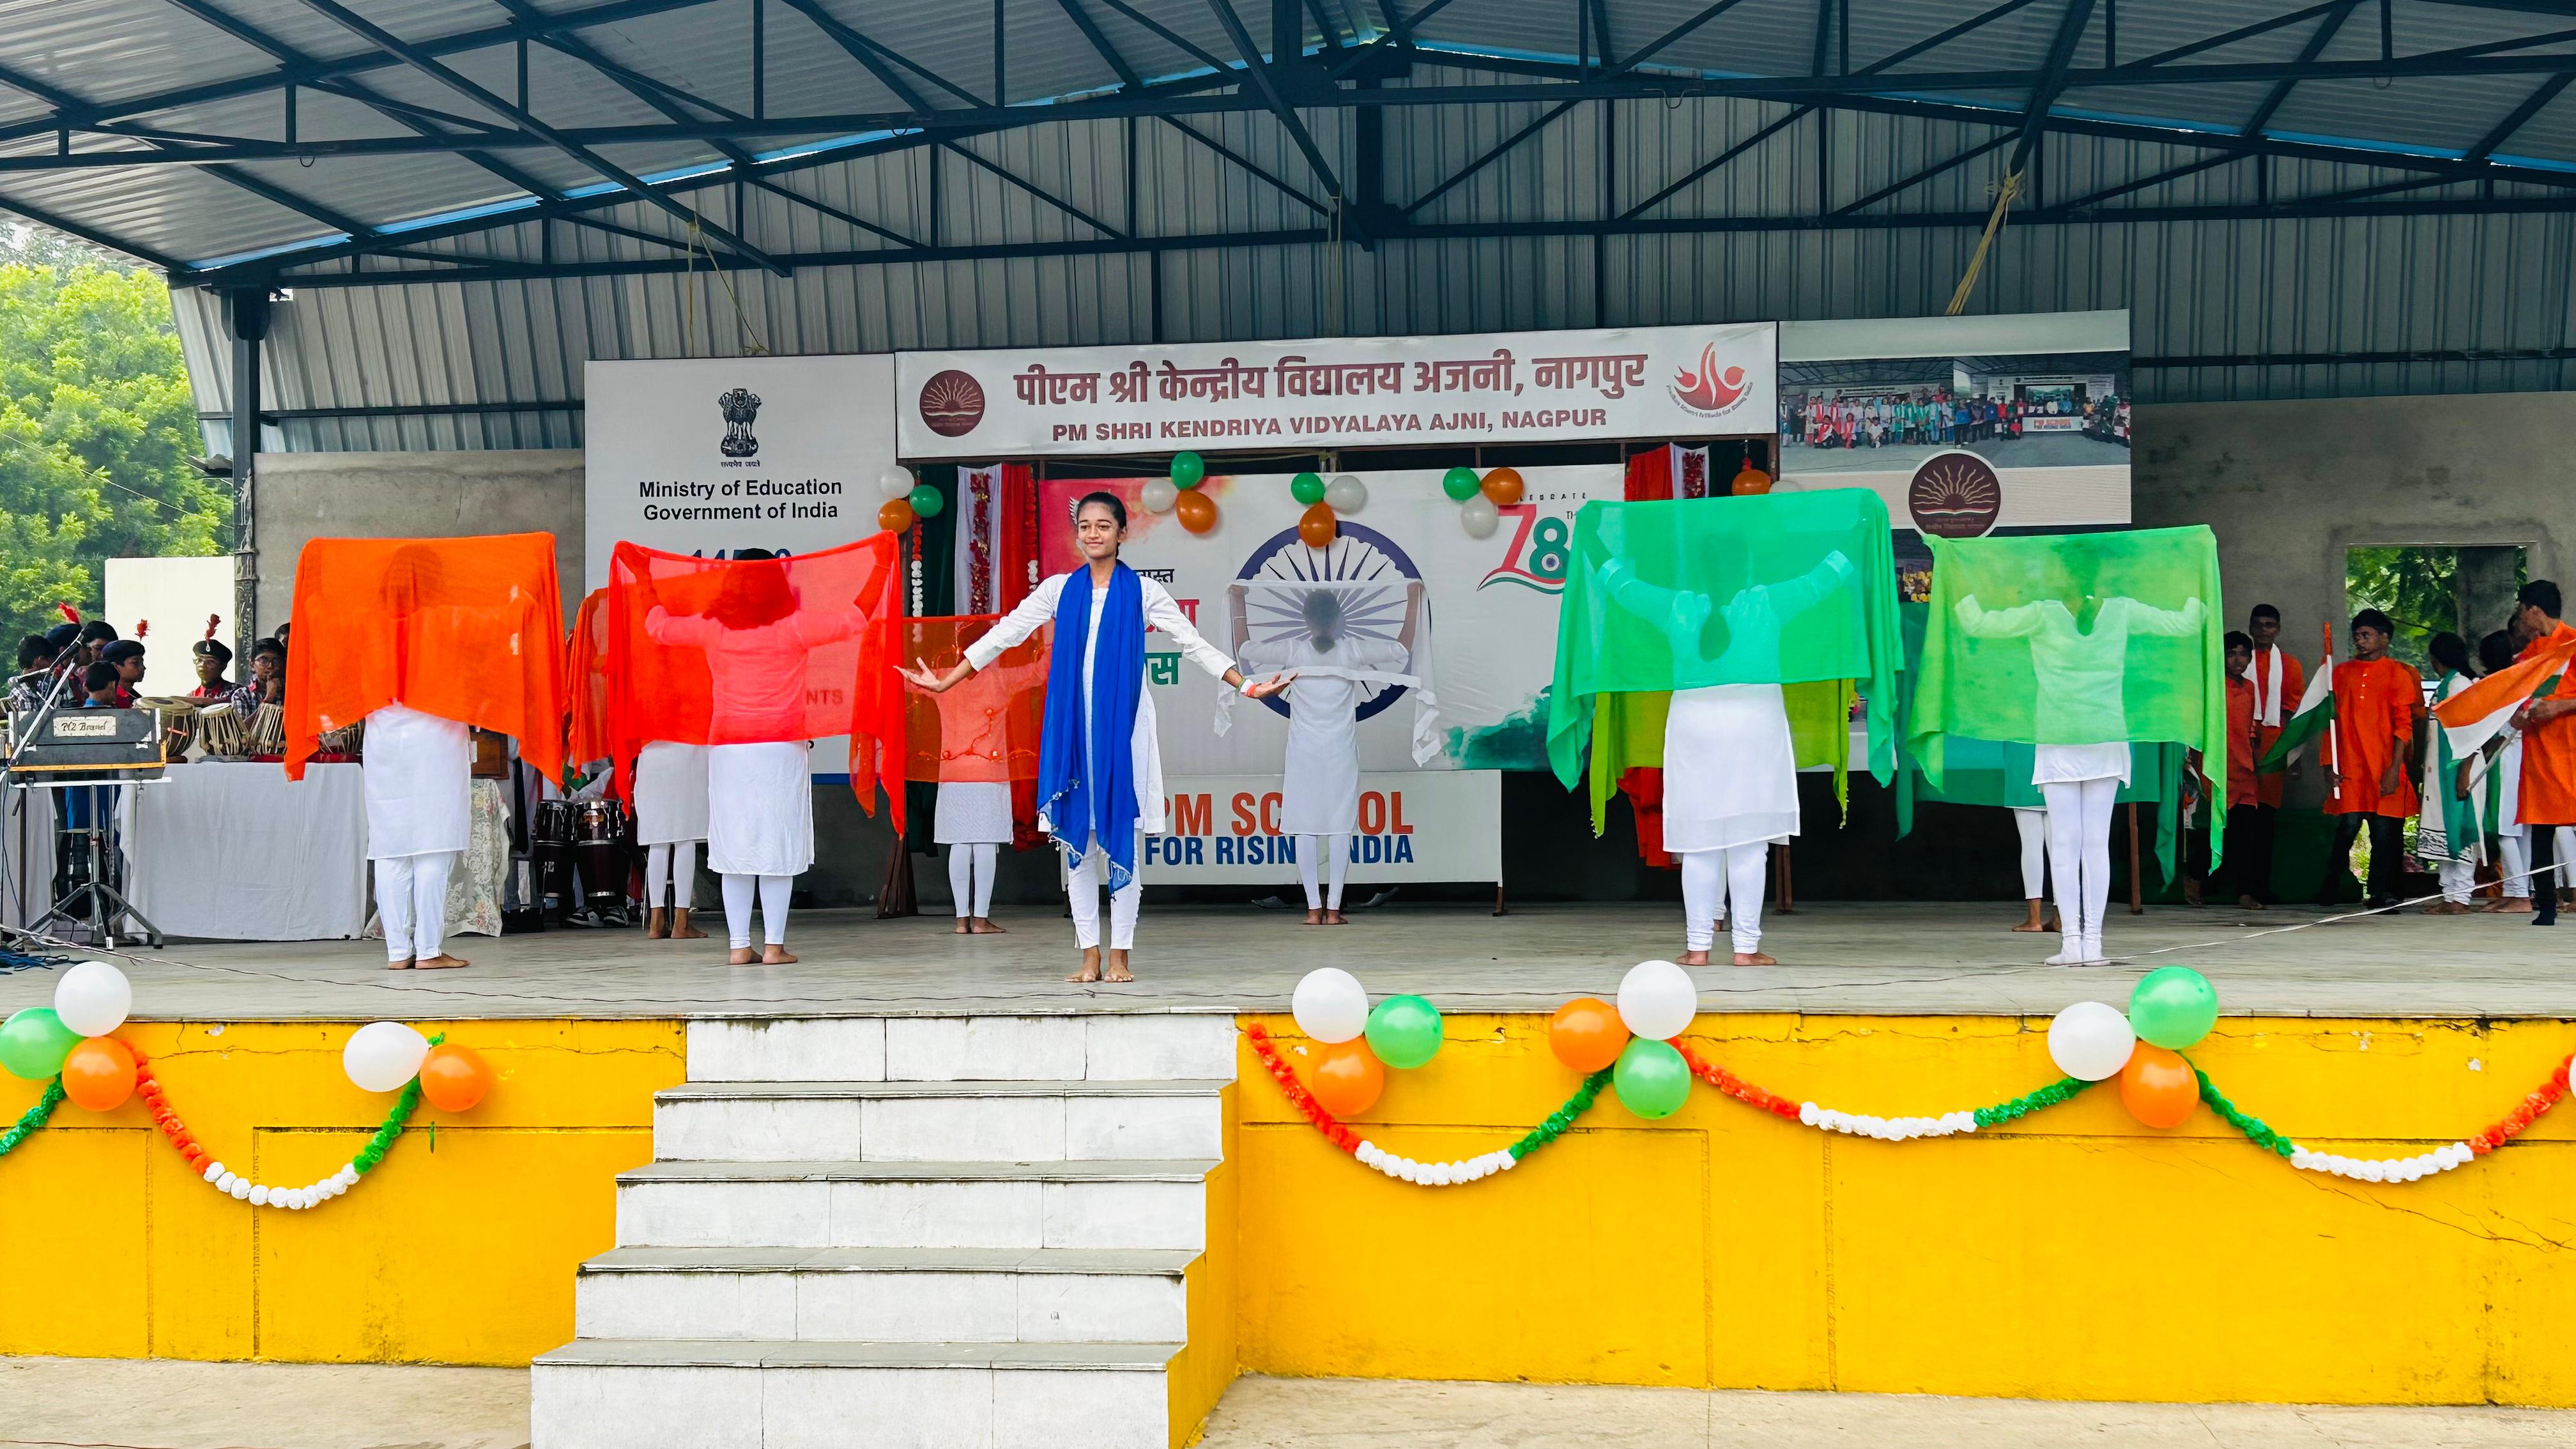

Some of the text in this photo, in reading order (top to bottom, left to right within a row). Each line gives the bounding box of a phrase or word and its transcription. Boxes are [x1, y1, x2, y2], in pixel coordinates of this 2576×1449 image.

[1013, 348, 1648, 405] पीएम श्री केन्द्रीय विद्यालय अजनी, नागपुर
[1053, 409, 1606, 441] PM SHRI KENDRIYA VIDYALAYA AJNI, NAGPUR
[639, 479, 842, 500] Ministry of Education
[643, 502, 838, 521] Government of India
[1165, 791, 1414, 836] M SCOL
[1145, 834, 1414, 866] FOR RISIN NDIA
